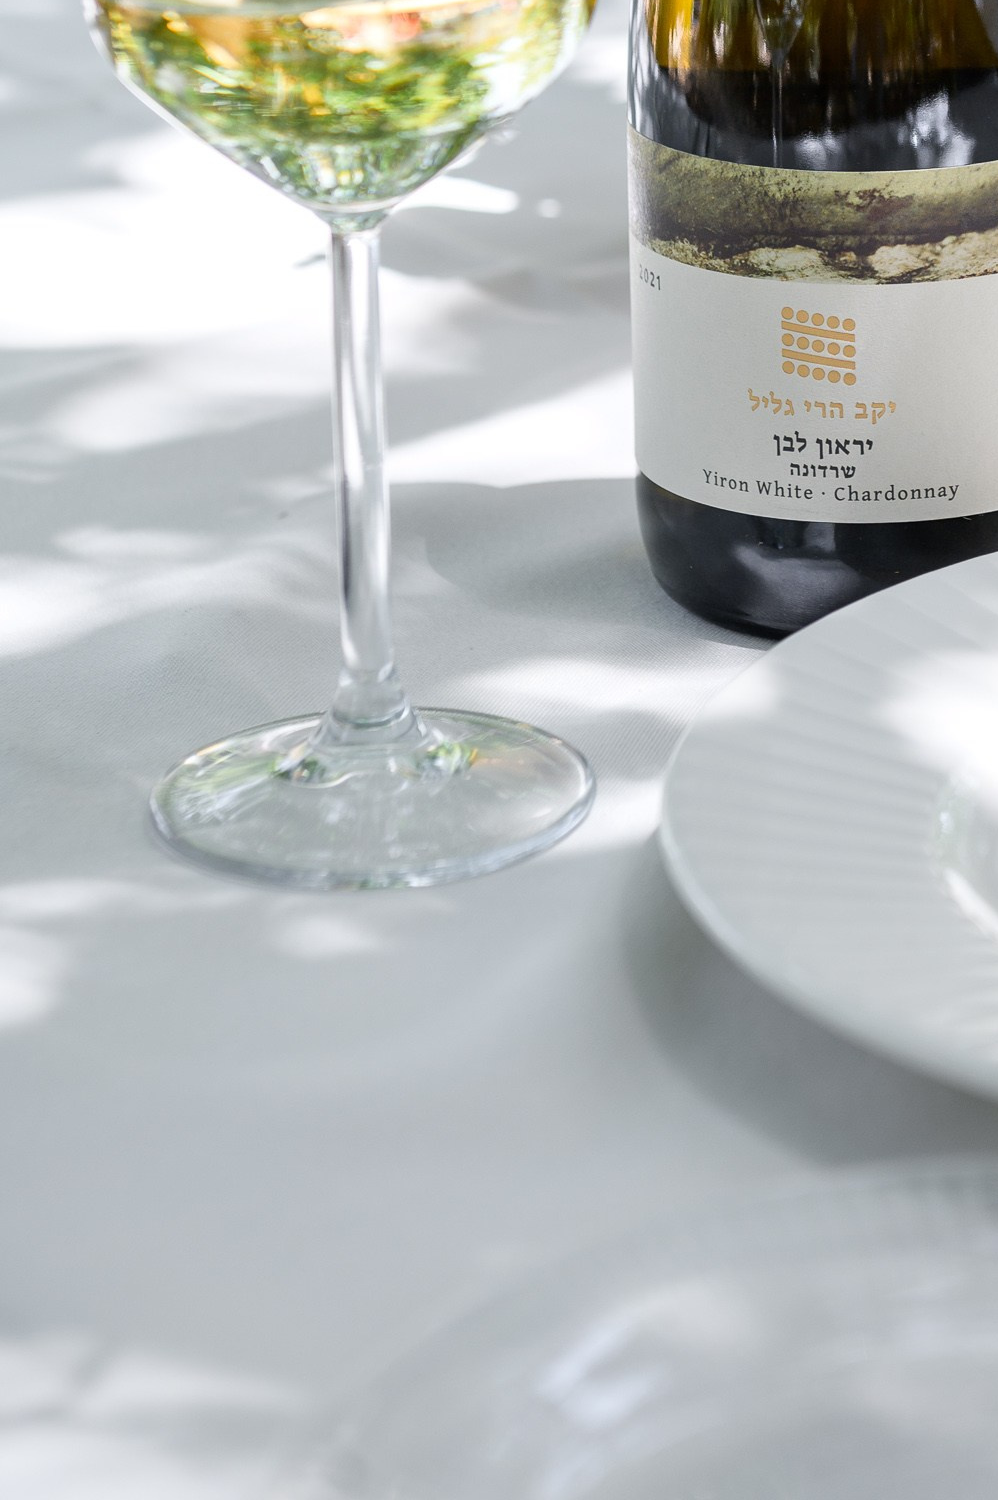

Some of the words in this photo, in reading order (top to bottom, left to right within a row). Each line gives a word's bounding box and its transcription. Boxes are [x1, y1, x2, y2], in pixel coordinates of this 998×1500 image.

[639, 263, 661, 291] 2021
[748, 388, 795, 416] גליל
[804, 400, 844, 419] הרי
[855, 401, 897, 425] יקב
[773, 430, 807, 456] לבן
[815, 437, 874, 460] יראון
[790, 462, 856, 479] שרדונה
[702, 468, 750, 493] Yiron
[755, 480, 814, 500] White
[834, 484, 960, 502] Chardonnay
